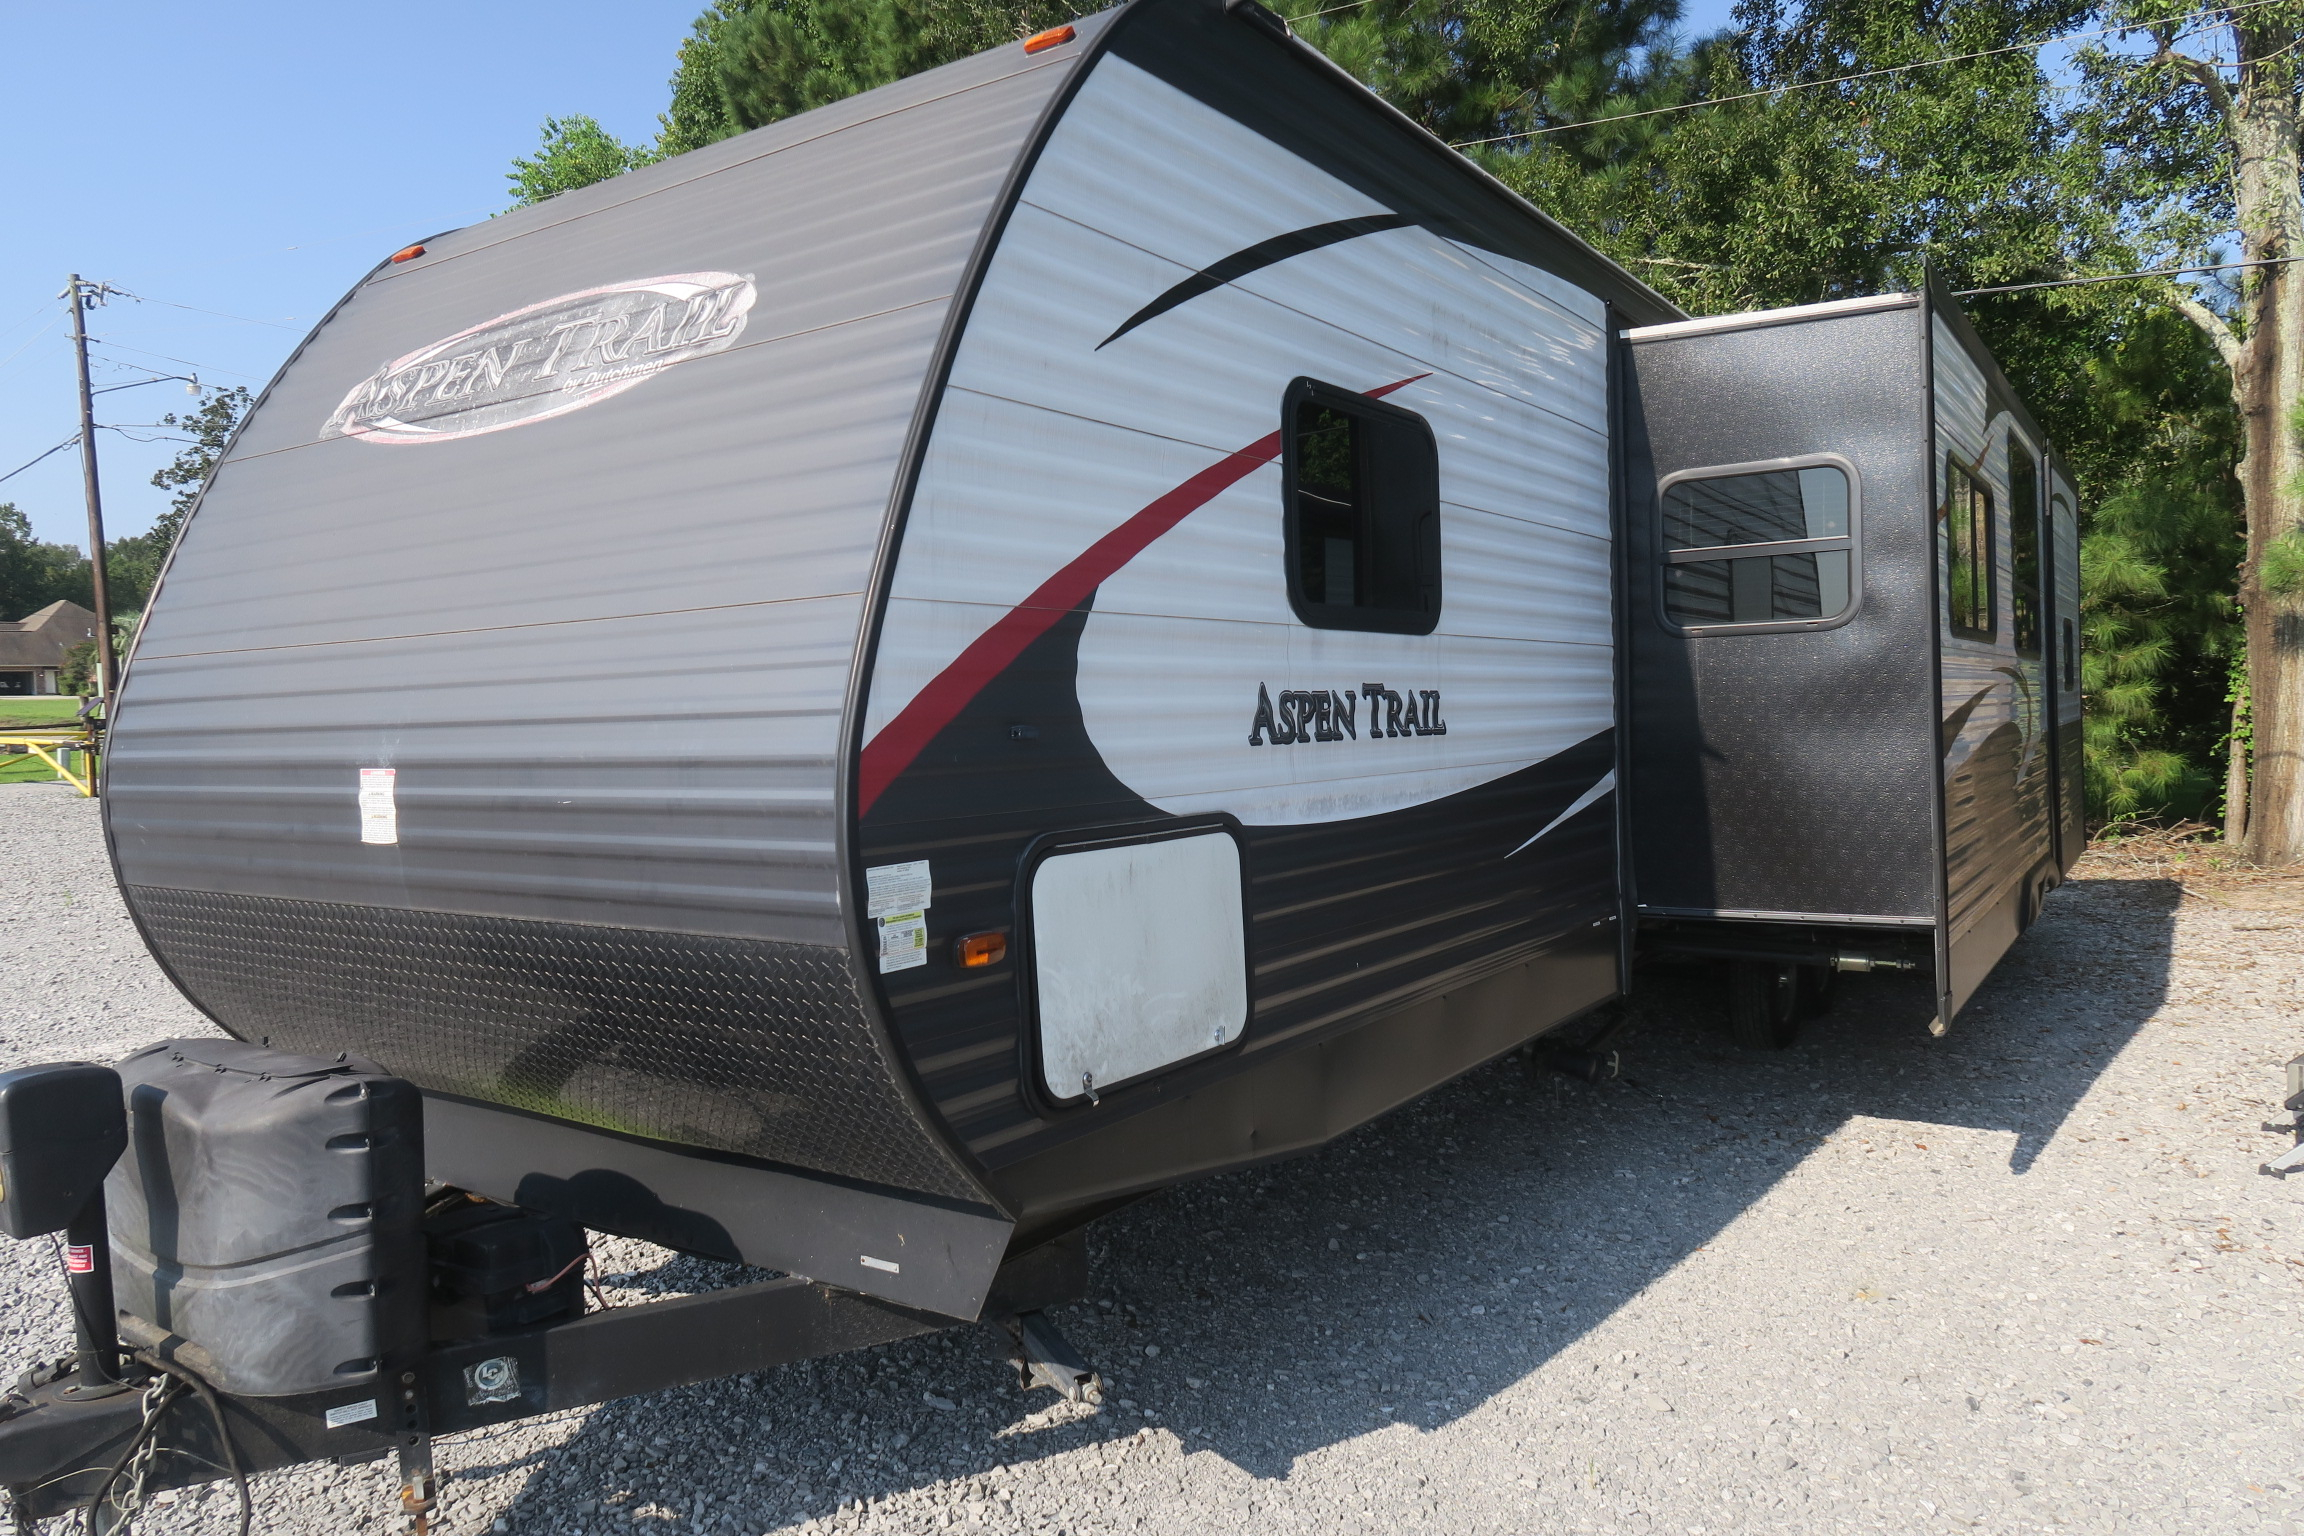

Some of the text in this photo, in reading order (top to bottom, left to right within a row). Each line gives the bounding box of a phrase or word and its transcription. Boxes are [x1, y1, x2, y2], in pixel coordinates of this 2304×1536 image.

[330, 281, 746, 426] ASPEN TRAIL
[561, 358, 665, 394] by Dutchmen
[1248, 681, 1447, 746] ASPEN TRAIL
